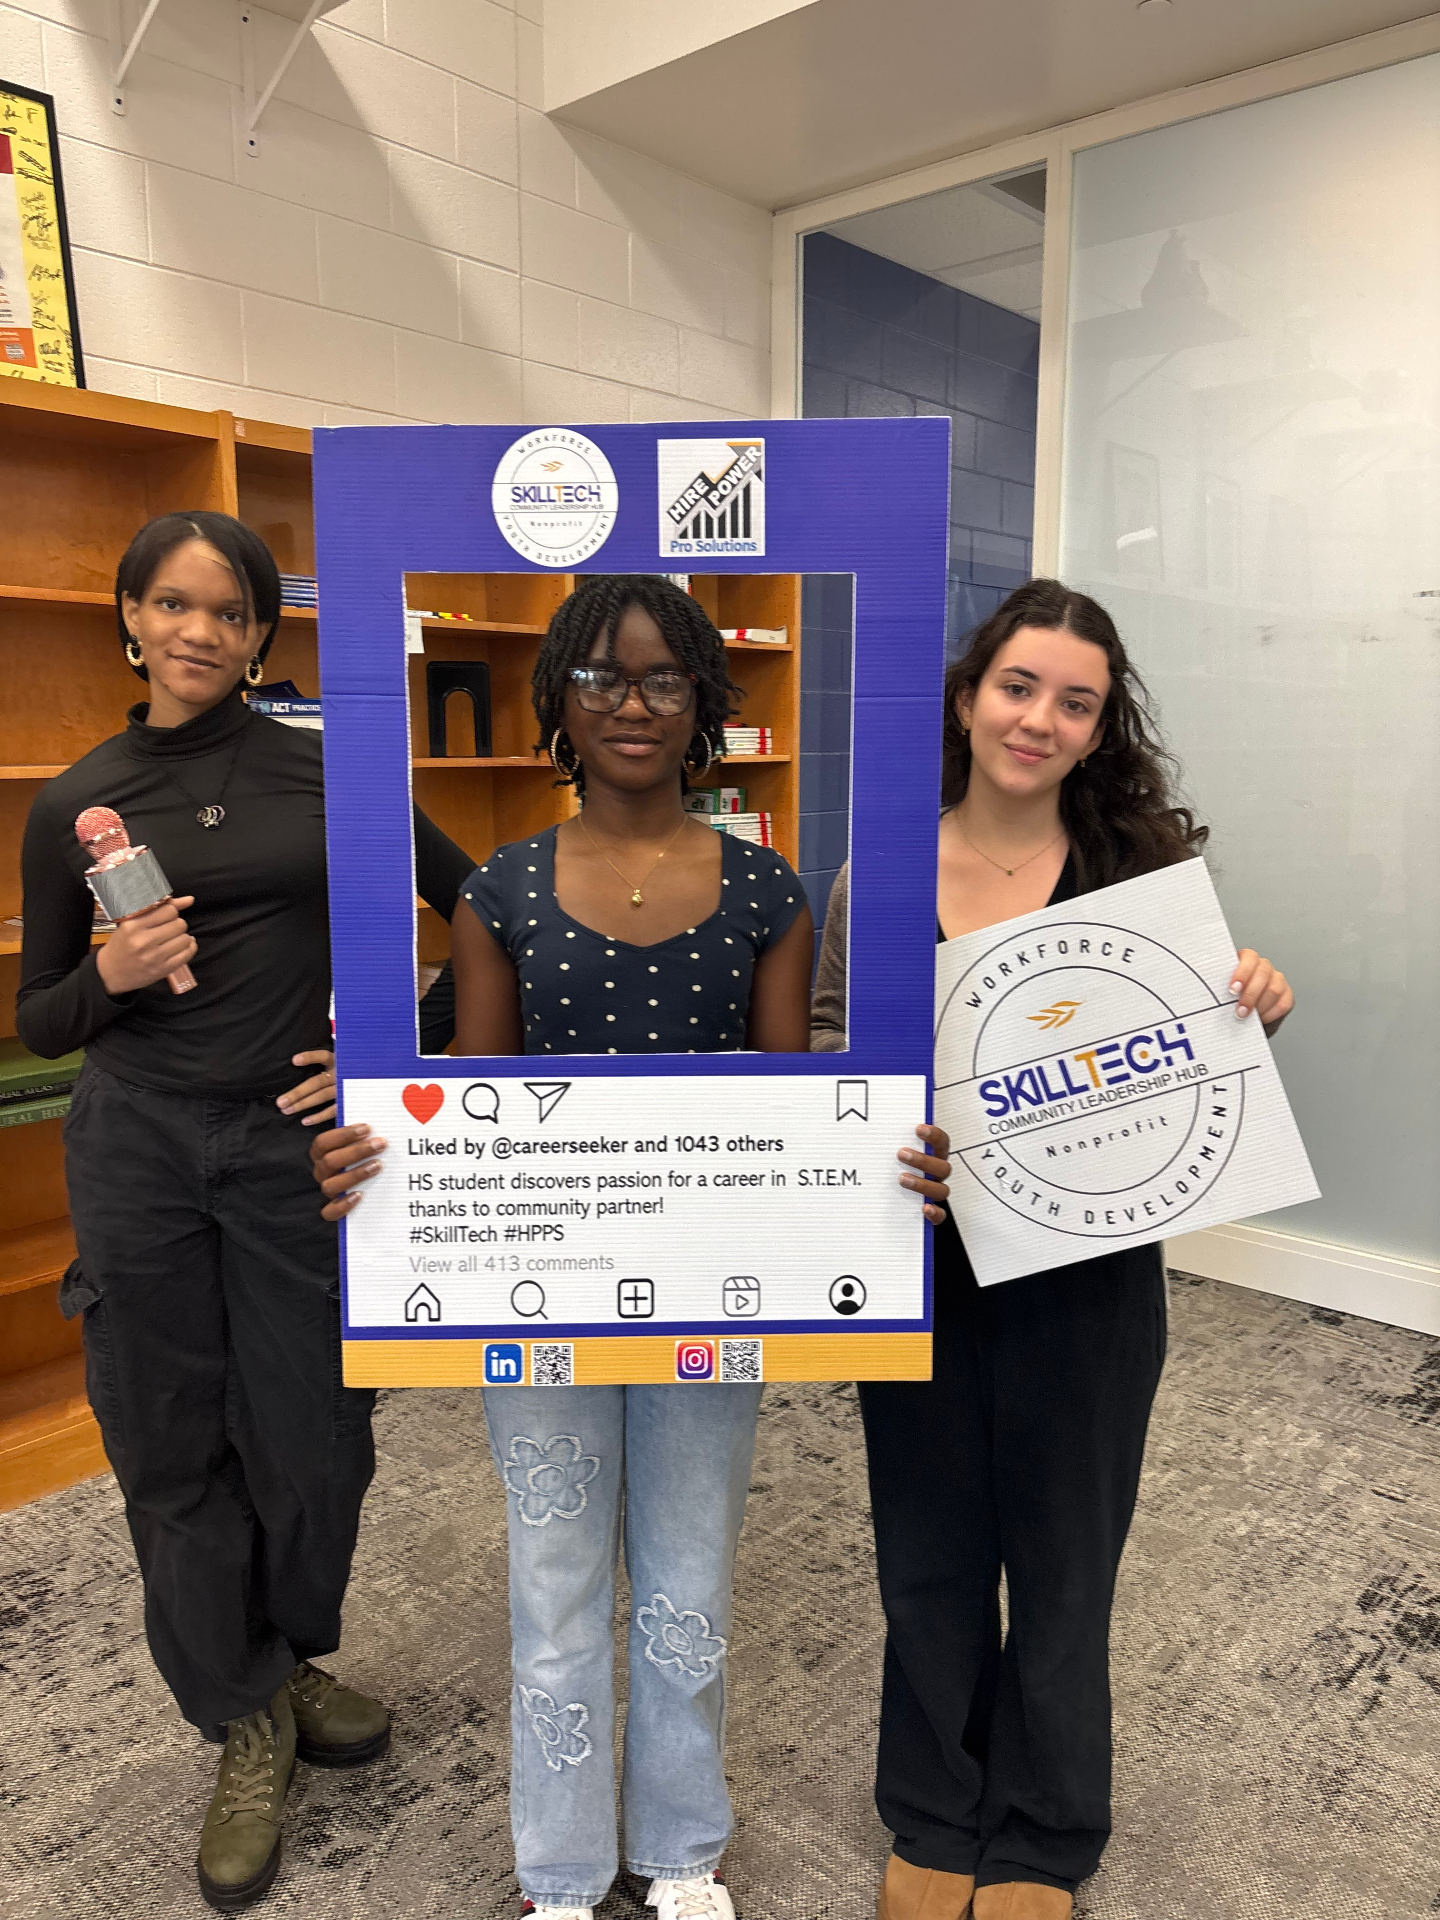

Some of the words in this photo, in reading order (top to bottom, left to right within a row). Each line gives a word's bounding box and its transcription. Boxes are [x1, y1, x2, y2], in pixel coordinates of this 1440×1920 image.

[518, 434, 591, 455] WORKFORCE
[708, 446, 762, 506] POWER
[511, 485, 601, 503] SKILLTECH
[669, 478, 709, 521] HIRE
[530, 520, 583, 528] Nonprofit
[503, 515, 531, 552] YOUTH
[536, 514, 609, 563] DEVELOPMENT
[670, 540, 692, 553] Pro
[696, 540, 757, 553] Solutions
[273, 703, 290, 712] ACT
[965, 939, 1135, 1010] WORKFORCE
[979, 1023, 1195, 1117] SKILLTECH
[988, 1101, 1075, 1136] COMMUNITY
[1080, 1073, 1172, 1110] LEADERSHIP
[1176, 1063, 1209, 1082] HUB
[408, 1138, 456, 1155] Liked
[464, 1138, 486, 1159] by
[492, 1136, 628, 1160] @careerseeker
[634, 1135, 668, 1152] and
[675, 1136, 719, 1152] 1043
[726, 1135, 784, 1151] others
[1047, 1115, 1167, 1157] Nonprofit
[981, 1148, 1060, 1217] YOUTH
[1085, 1084, 1227, 1225] DEVELOPMENT
[408, 1173, 433, 1190] HS
[438, 1173, 505, 1190] student
[511, 1172, 591, 1190] discovers
[597, 1171, 662, 1192] passion
[668, 1170, 692, 1187] for
[697, 1175, 708, 1187] a
[713, 1173, 766, 1187] career
[771, 1169, 786, 1186] in
[798, 1169, 862, 1186] S.T.E.M.
[408, 1200, 467, 1217] thanks
[472, 1201, 490, 1217] to
[496, 1198, 591, 1219] community
[597, 1197, 664, 1219] partner!
[409, 1225, 498, 1243] #SkillTech
[504, 1224, 564, 1242] #HPPS
[409, 1255, 451, 1273] View
[458, 1255, 477, 1272] all
[484, 1255, 520, 1272] 413
[526, 1254, 615, 1272] comments
[491, 1352, 516, 1378] in
